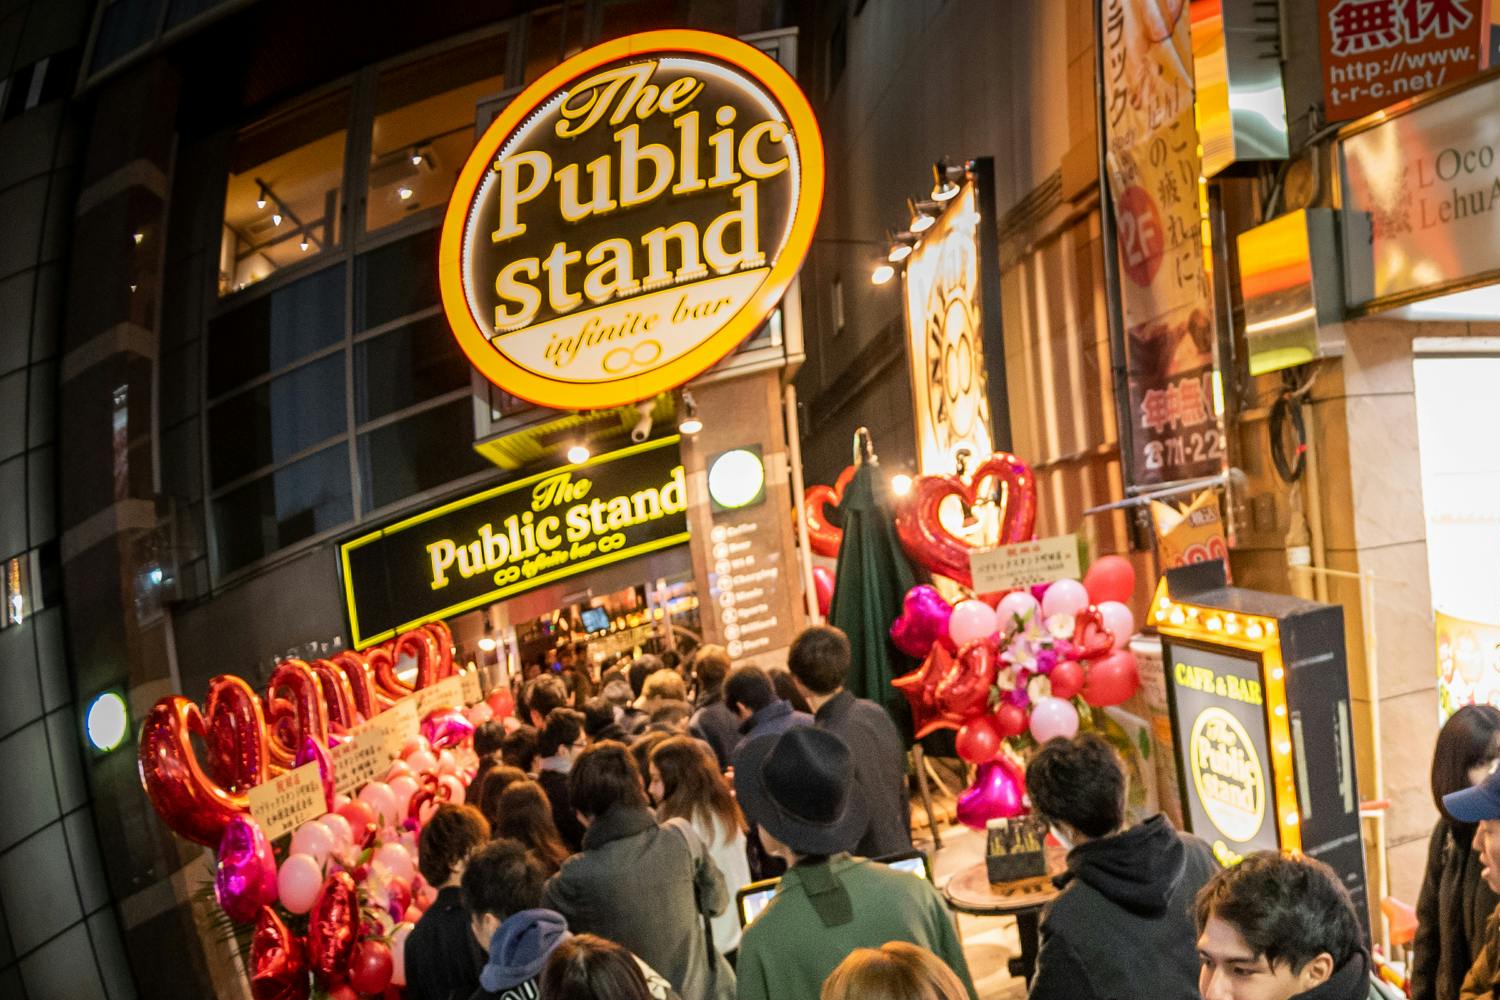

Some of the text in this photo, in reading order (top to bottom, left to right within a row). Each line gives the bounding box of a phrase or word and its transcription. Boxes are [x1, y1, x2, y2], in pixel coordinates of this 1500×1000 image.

[1330, 47, 1476, 84] http://www.
[1331, 67, 1446, 105] t-r-c.net/
[556, 60, 705, 138] The
[493, 105, 790, 243] Public
[1416, 145, 1494, 190] LOco
[1119, 209, 1156, 266] 2F
[544, 292, 733, 367] infinite bar
[531, 473, 592, 511] The
[427, 507, 562, 591] Public
[1175, 662, 1215, 693] CAFE
[1226, 675, 1262, 705] BAR
